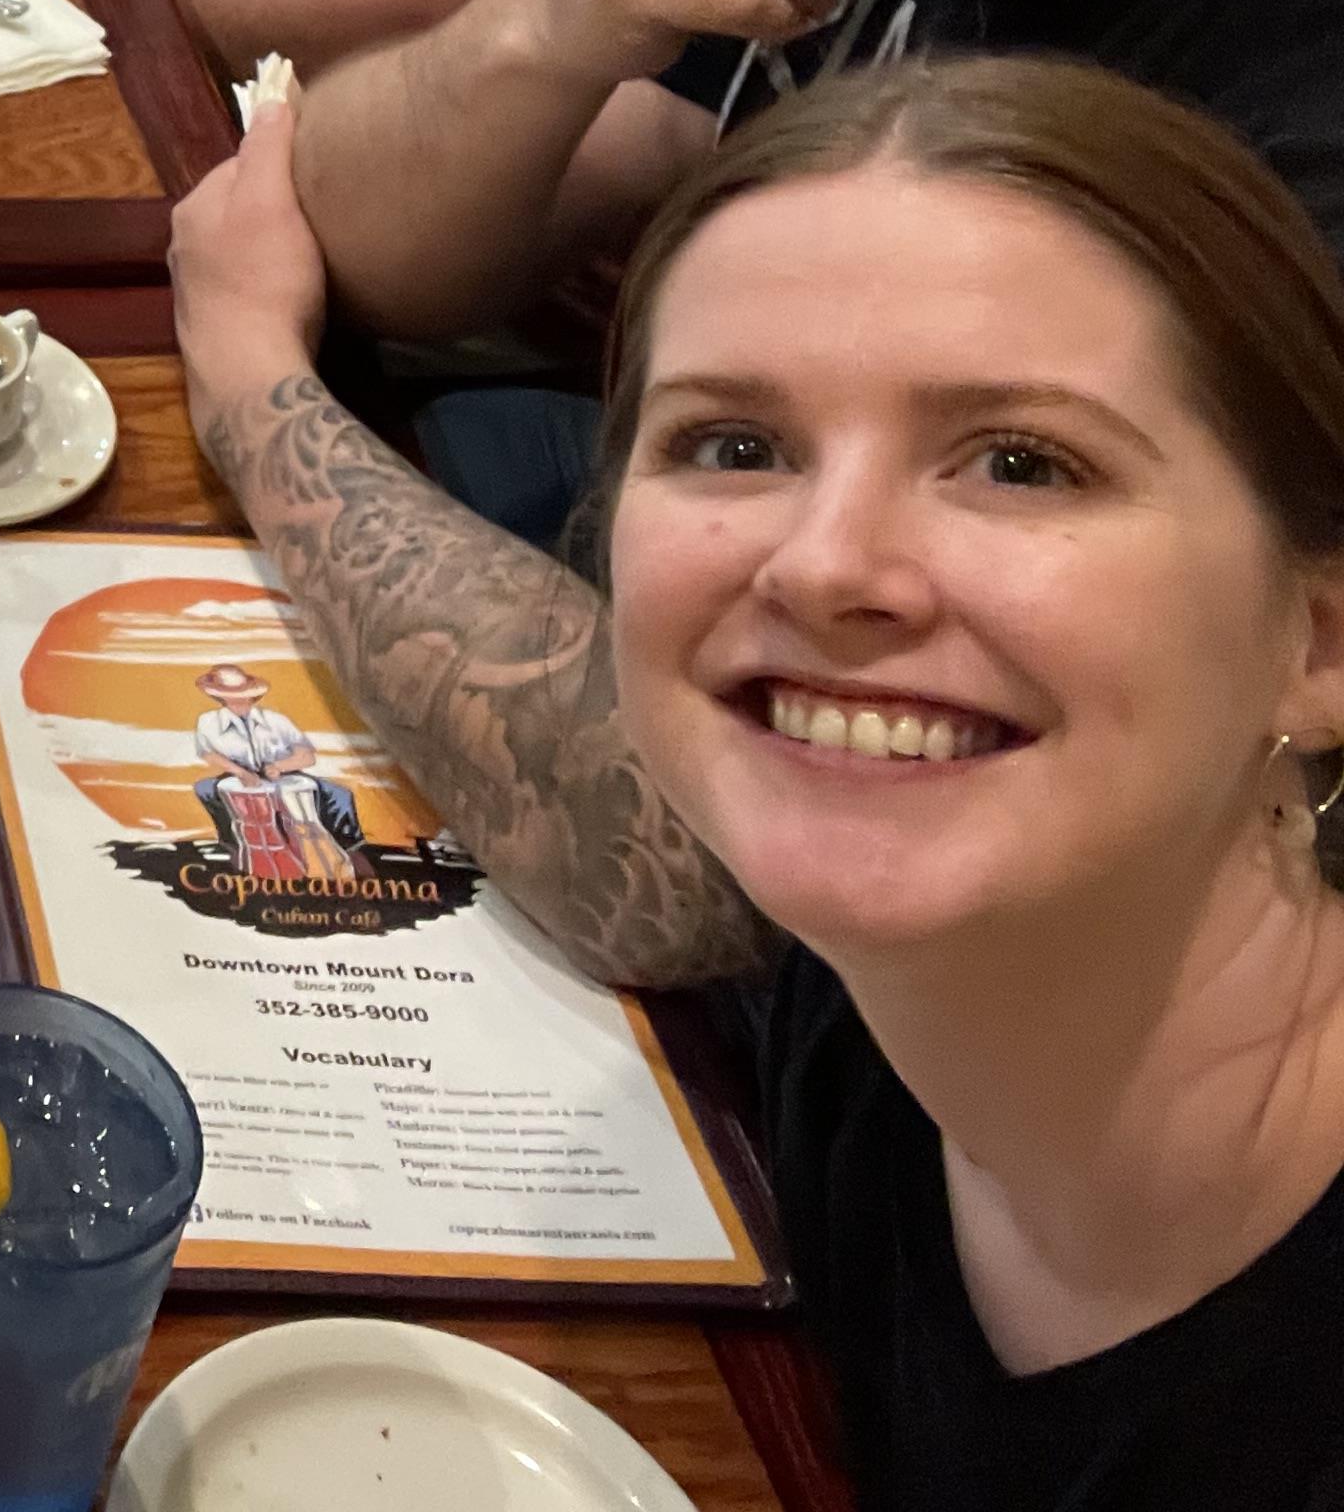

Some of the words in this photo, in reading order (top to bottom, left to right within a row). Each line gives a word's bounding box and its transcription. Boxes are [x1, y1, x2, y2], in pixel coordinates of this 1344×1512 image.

[179, 864, 441, 909] Copacabana
[262, 905, 329, 925] Cuban
[183, 952, 317, 976] Downtown
[327, 961, 407, 981] Mount
[415, 966, 475, 984] Dora
[294, 980, 336, 992] Since
[255, 998, 429, 1023] 352-385-9000
[283, 1046, 432, 1072] Vocabulary
